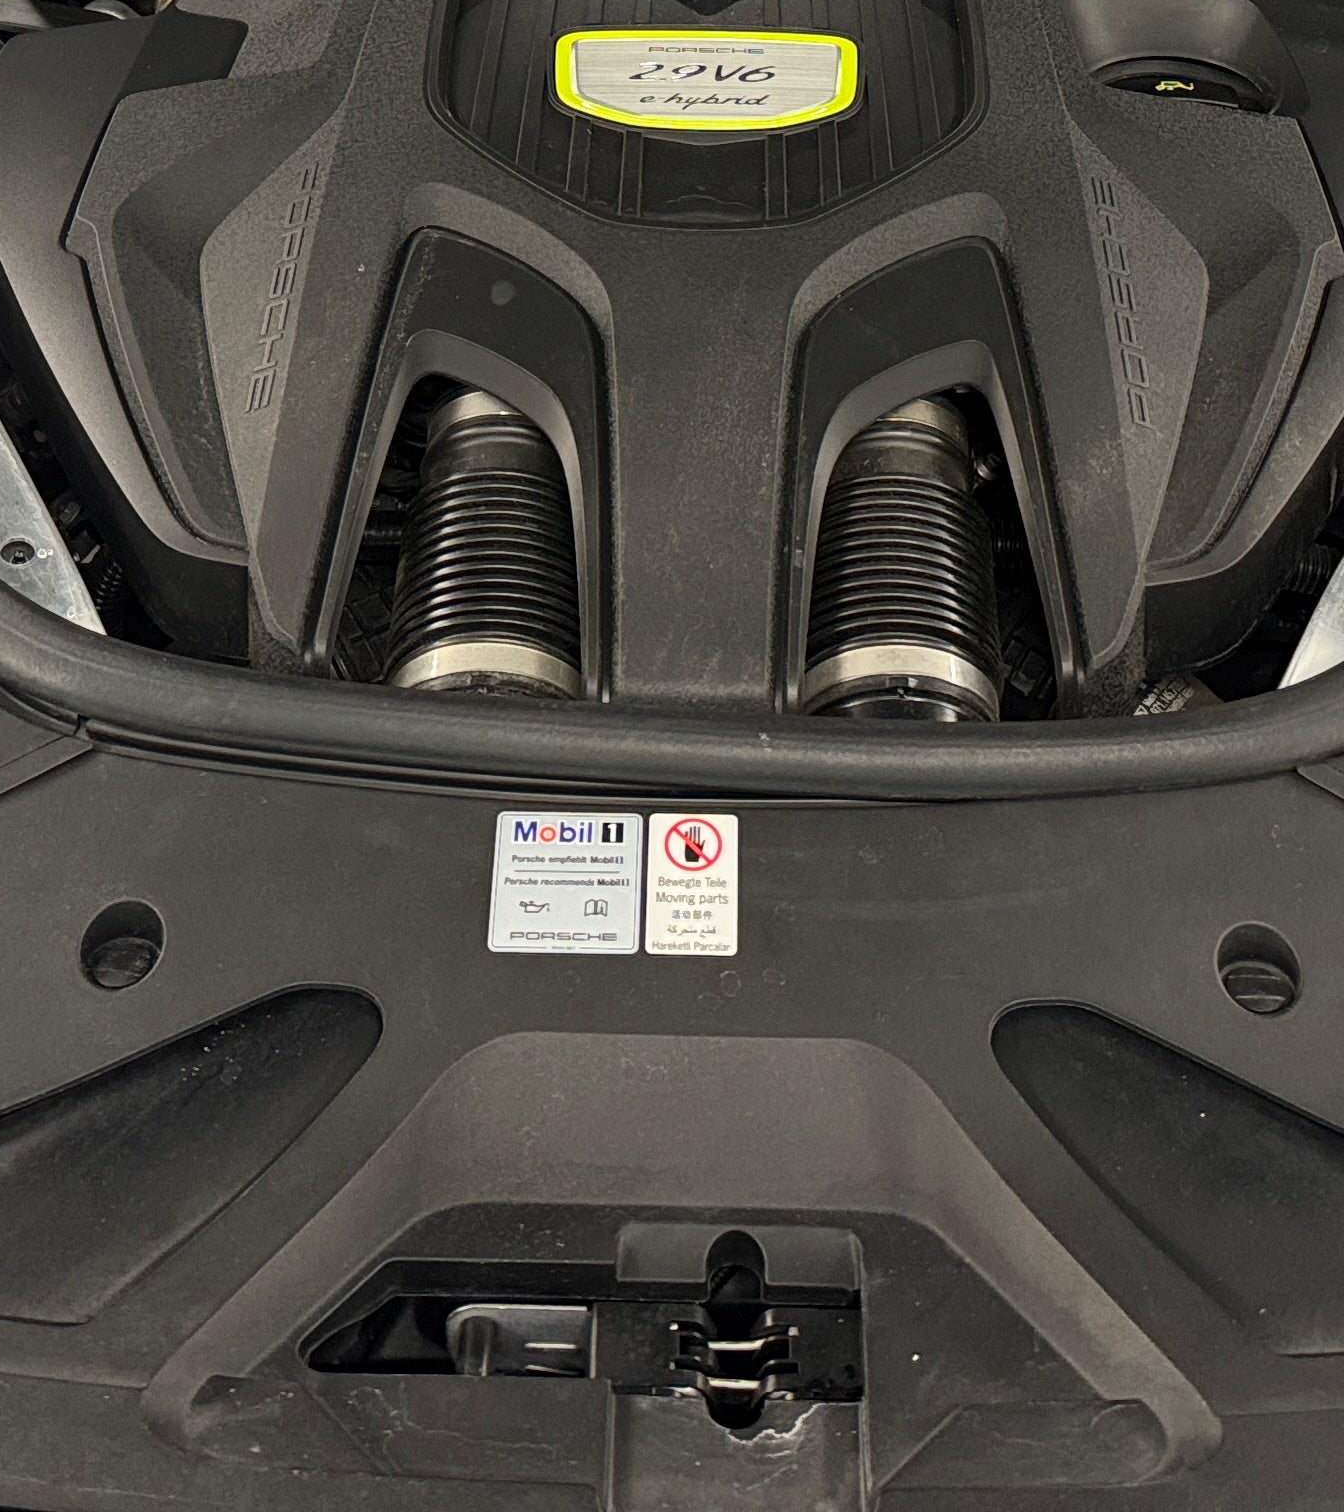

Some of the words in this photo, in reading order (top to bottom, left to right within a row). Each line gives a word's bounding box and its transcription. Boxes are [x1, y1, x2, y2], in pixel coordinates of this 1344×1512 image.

[648, 46, 765, 54] PORSCHE
[628, 61, 707, 81] 2.9
[715, 64, 775, 82] V6
[639, 92, 771, 110] e-hybrid
[513, 821, 593, 843] Mobil
[511, 854, 545, 863] Porsche
[504, 876, 538, 885] Porsche
[657, 876, 701, 889] Bewegte
[705, 876, 727, 888] Teile
[655, 891, 695, 905] Moving
[698, 893, 729, 905] parts
[510, 931, 618, 942] PORSCHE
